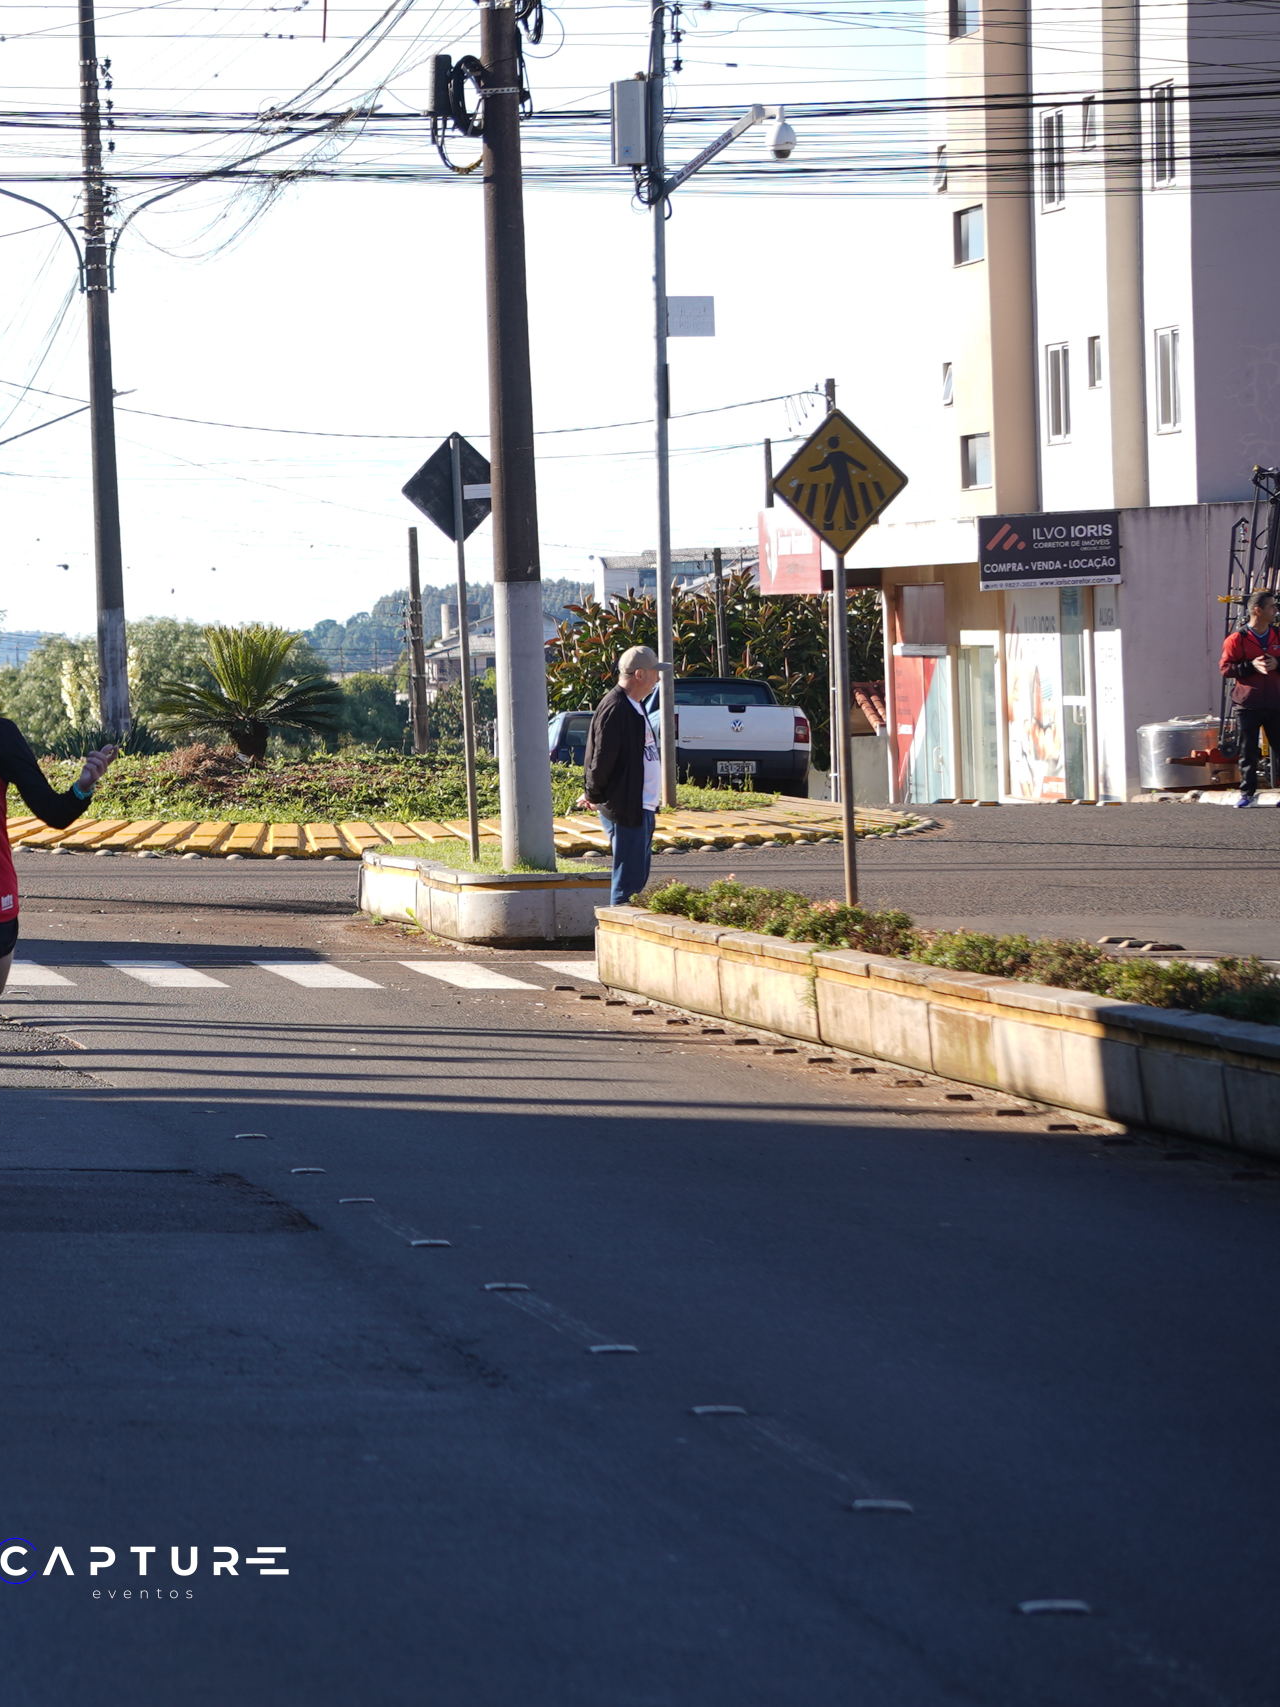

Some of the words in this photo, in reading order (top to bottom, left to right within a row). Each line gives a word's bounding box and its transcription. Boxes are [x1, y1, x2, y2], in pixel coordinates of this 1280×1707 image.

[1033, 526, 1066, 540] ILVO
[1070, 524, 1112, 538] IORIS
[1033, 541, 1070, 549] CORRETOR
[984, 563, 1024, 573] COMPRA
[1030, 560, 1062, 570] VENDA
[1069, 555, 1116, 569] LOCAÇÃO
